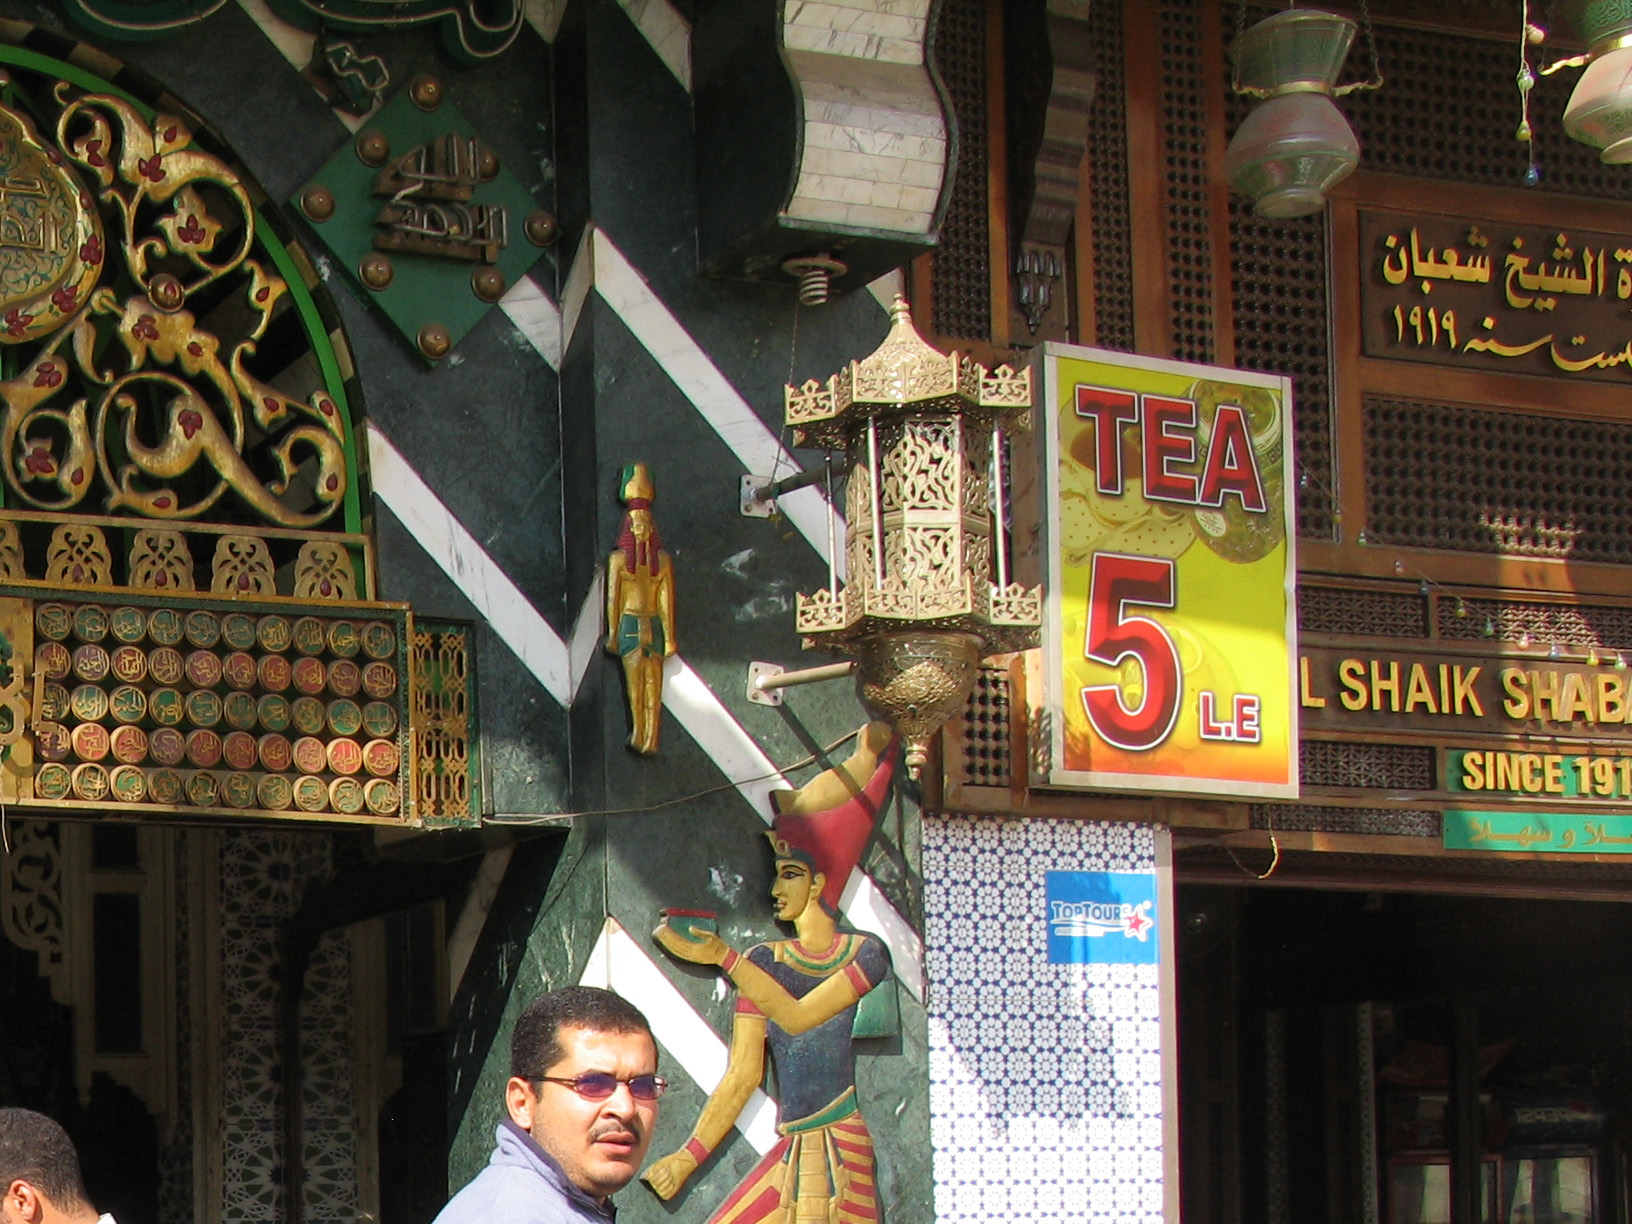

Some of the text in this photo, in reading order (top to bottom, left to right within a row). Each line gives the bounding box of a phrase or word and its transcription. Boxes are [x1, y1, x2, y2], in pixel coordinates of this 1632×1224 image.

[1382, 226, 1493, 295] شعبان
[1504, 232, 1606, 312] الشيخ
[1074, 383, 1267, 514] TEA
[1081, 551, 1184, 751] 5
[1338, 658, 1484, 717] SHAIK
[1462, 751, 1566, 793] SINCE
